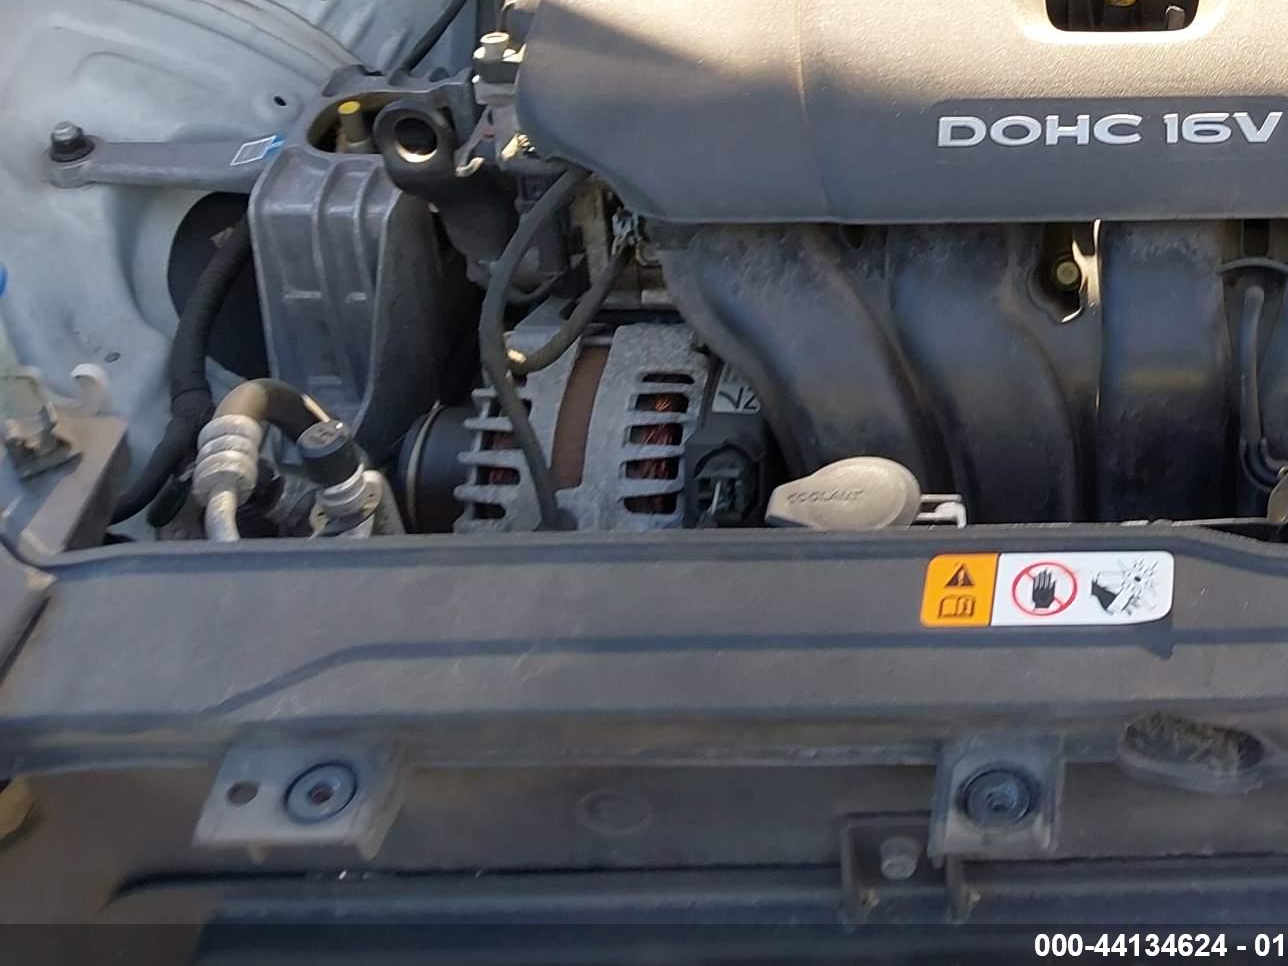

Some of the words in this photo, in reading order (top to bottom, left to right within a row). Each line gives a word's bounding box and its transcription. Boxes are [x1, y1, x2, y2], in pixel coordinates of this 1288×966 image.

[938, 113, 1143, 147] DOHC
[1163, 111, 1283, 144] 16V
[786, 490, 864, 506] COOLANT
